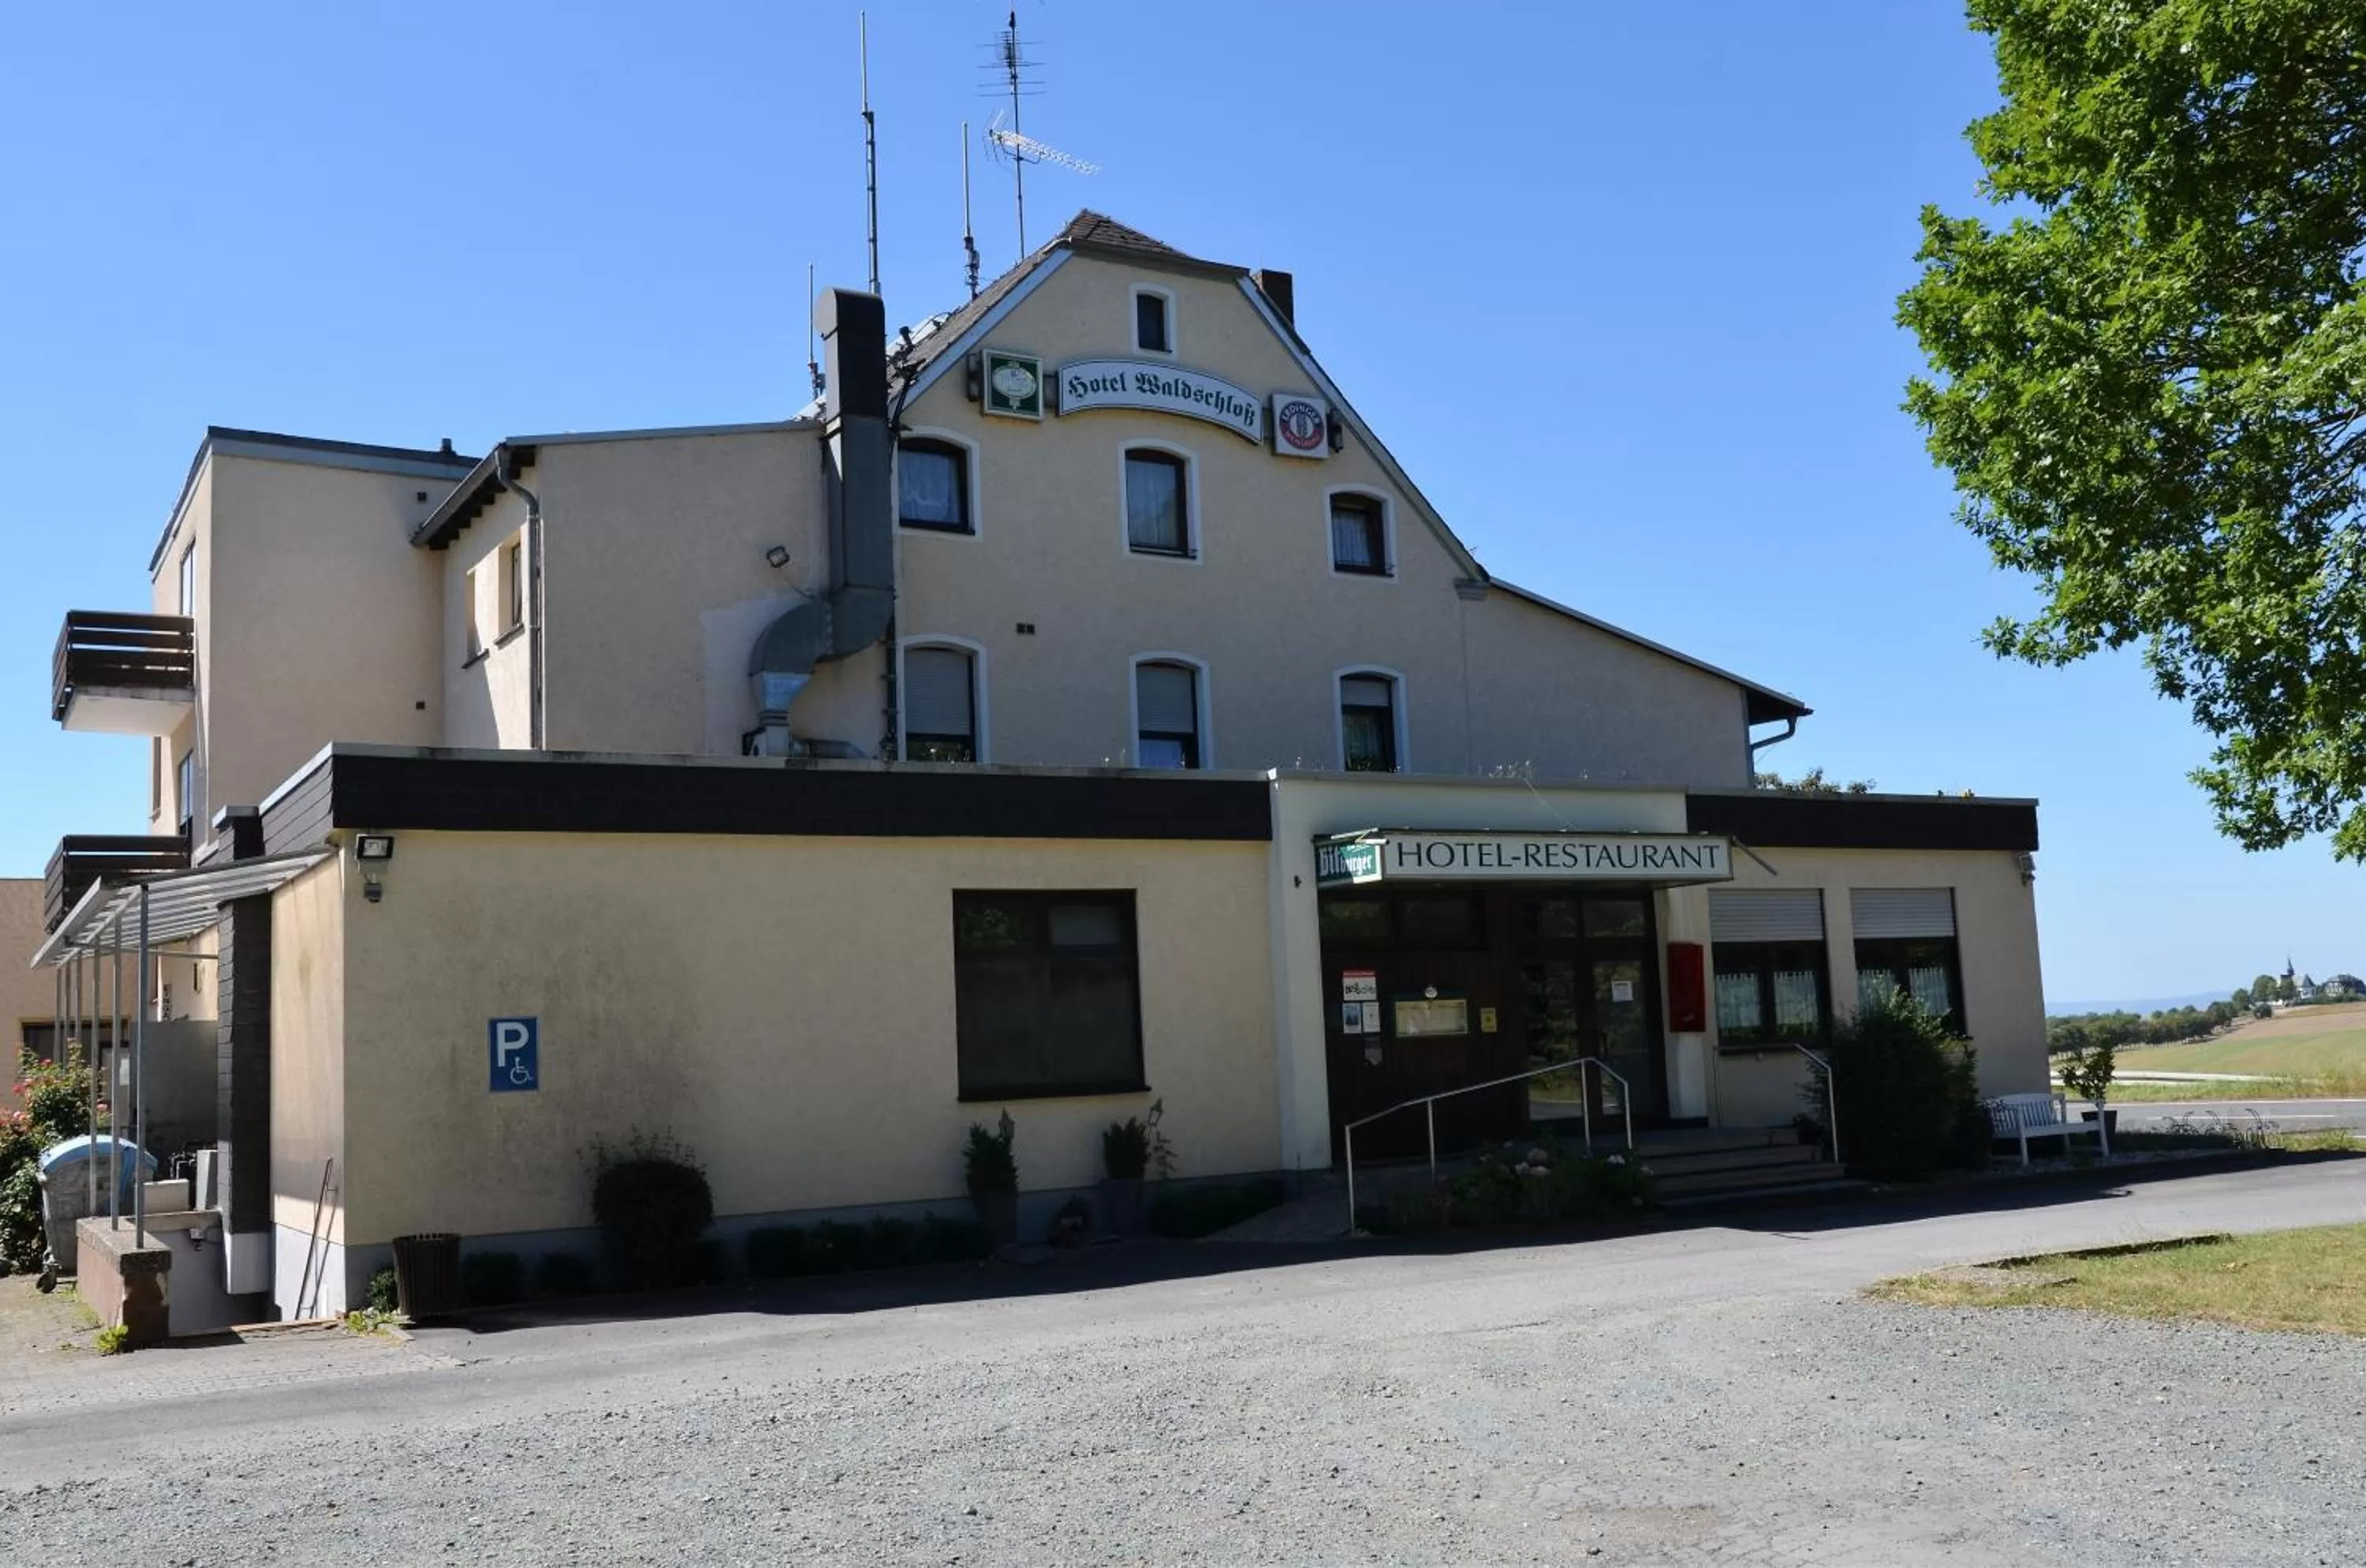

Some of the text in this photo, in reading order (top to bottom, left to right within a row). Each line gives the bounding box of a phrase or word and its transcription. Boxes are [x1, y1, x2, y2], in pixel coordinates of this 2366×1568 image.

[1069, 371, 1127, 399] Hotel
[1135, 372, 1256, 427] Waldschloß
[1281, 403, 1320, 423] ERDINGER
[1397, 842, 1720, 868] HOTEL-RESTAURANT
[497, 1022, 529, 1067] P
